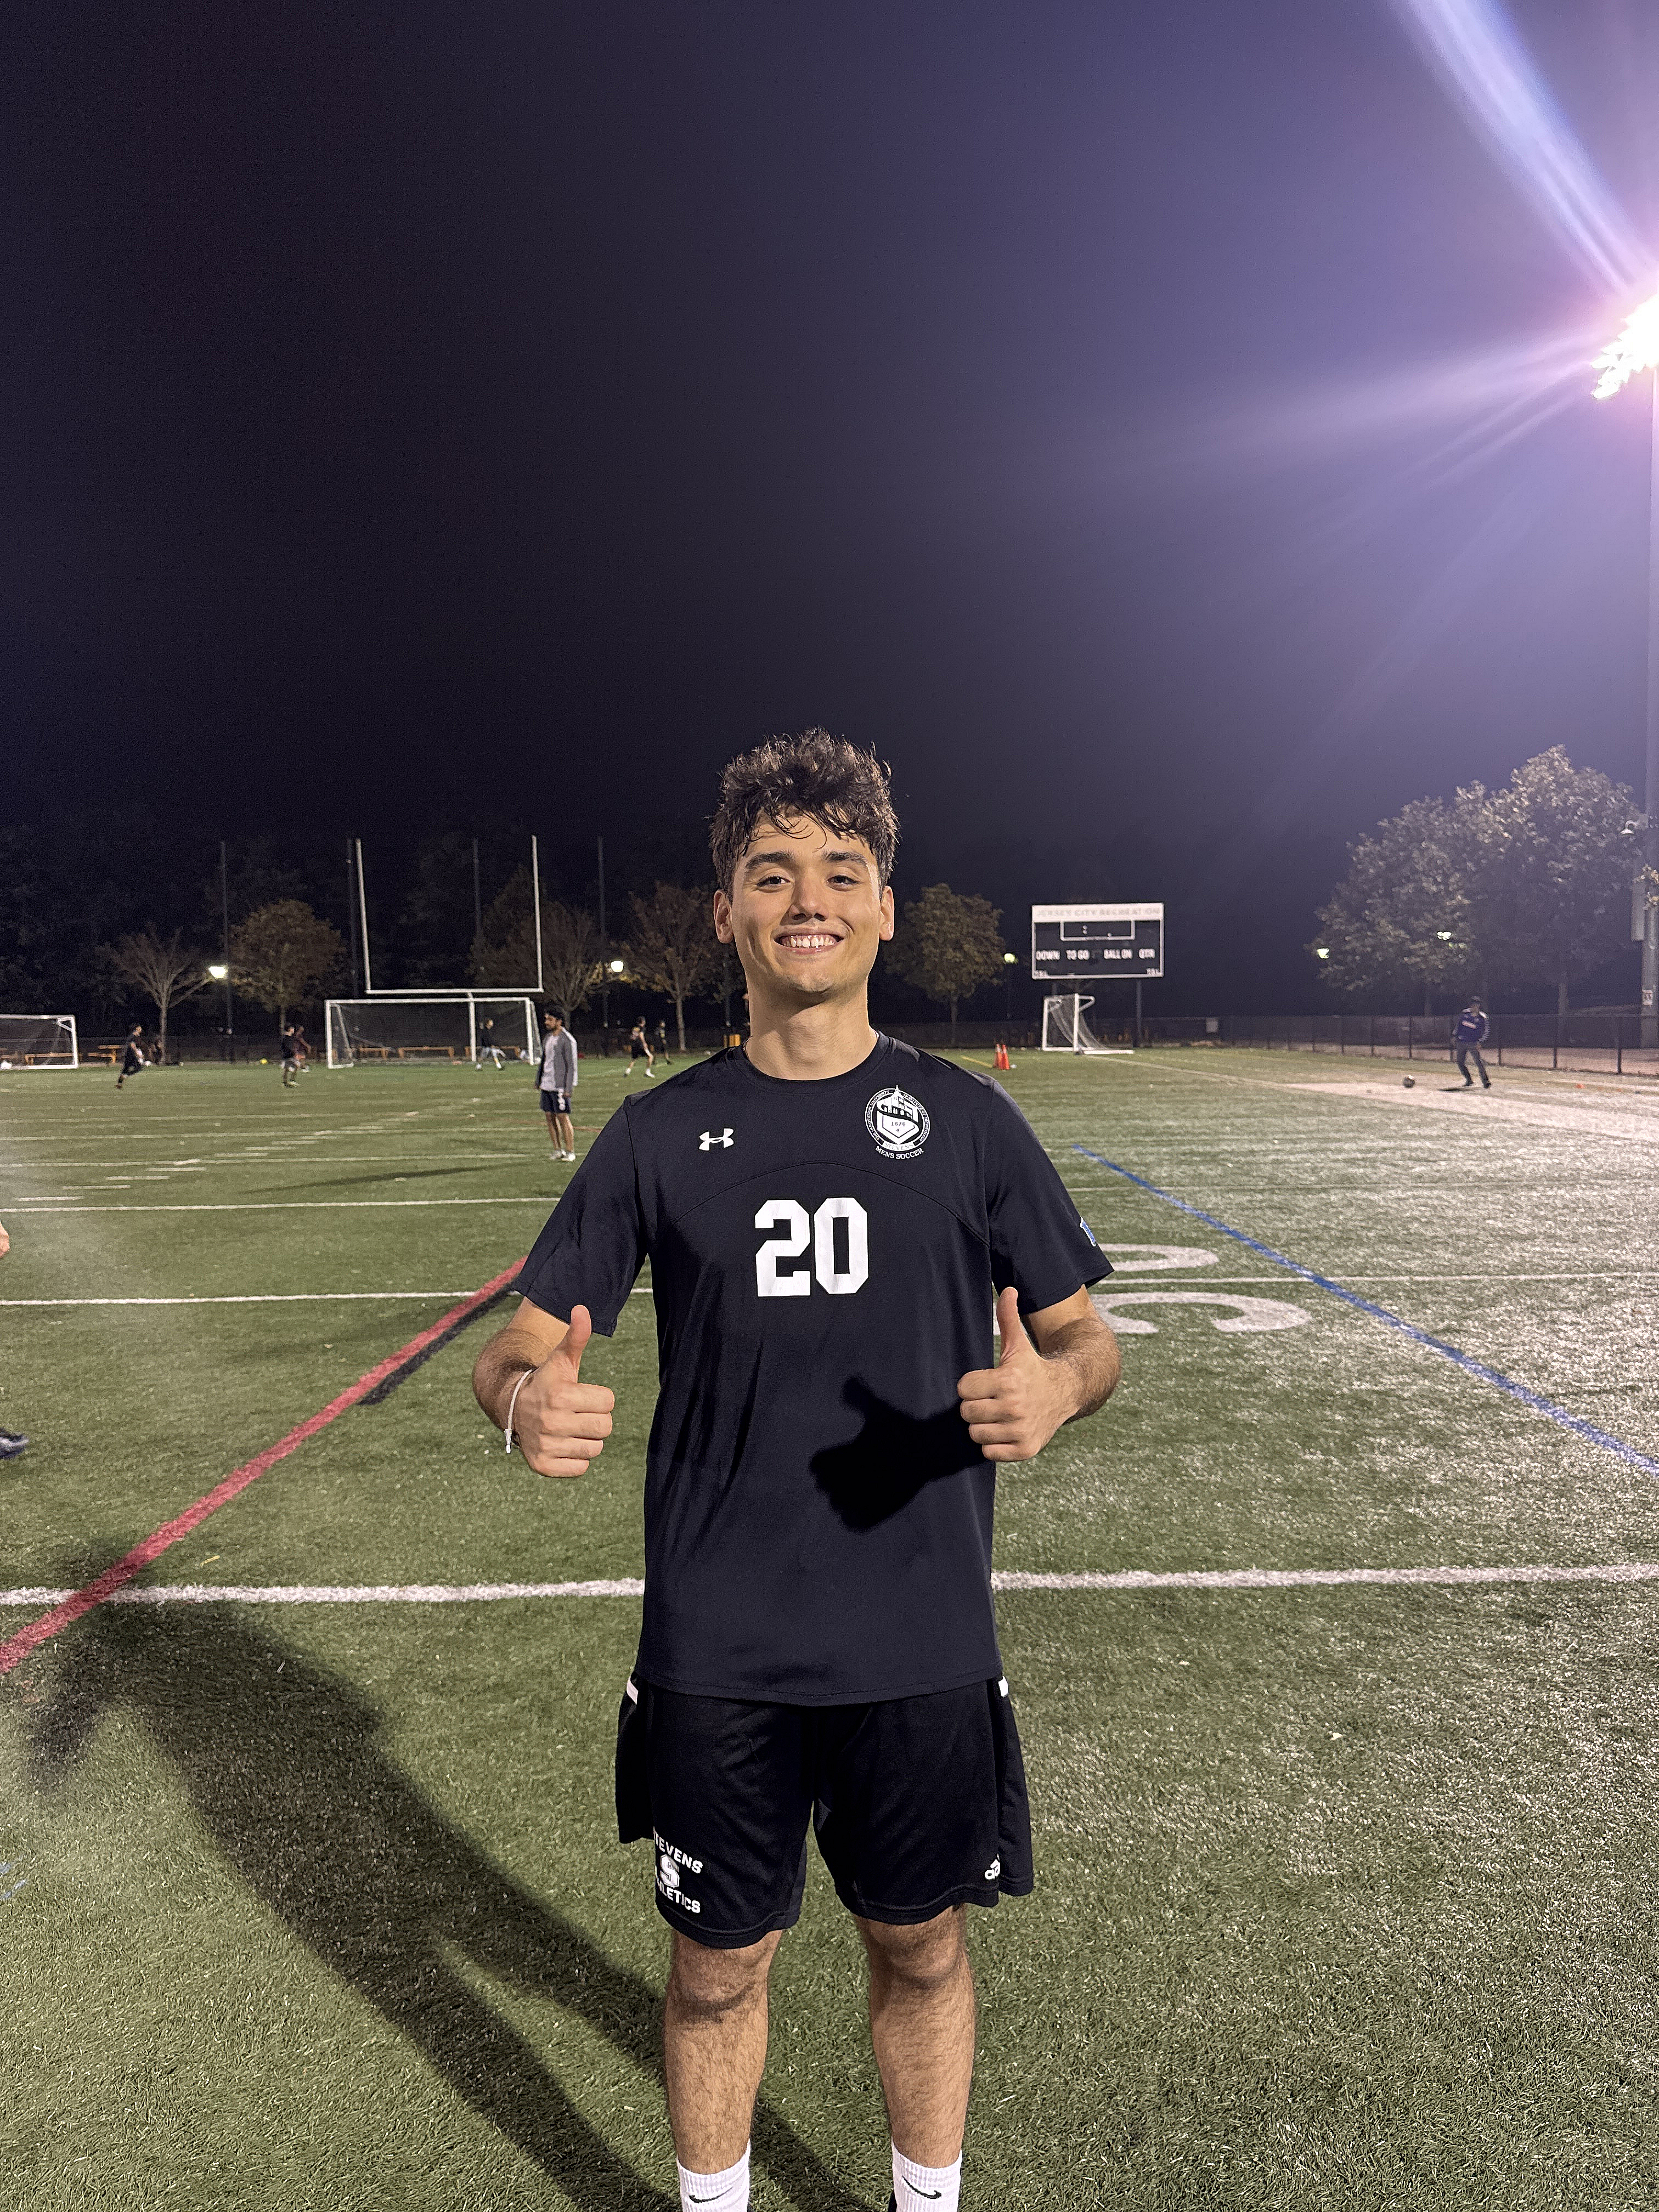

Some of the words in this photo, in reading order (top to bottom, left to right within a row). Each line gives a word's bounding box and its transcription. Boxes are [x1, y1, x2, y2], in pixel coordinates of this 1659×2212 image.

[1075, 908, 1097, 917] CITY
[1036, 950, 1060, 961] DOWN
[1066, 950, 1077, 960] TO
[1077, 950, 1090, 960] GO
[1104, 949, 1121, 960] BALL
[1121, 949, 1133, 959] ON
[1139, 949, 1155, 959] QTR
[895, 1148, 924, 1159] SOCCER
[754, 1197, 868, 1297] 20
[653, 1826, 703, 1874] TEVENS
[660, 1854, 680, 1888] S
